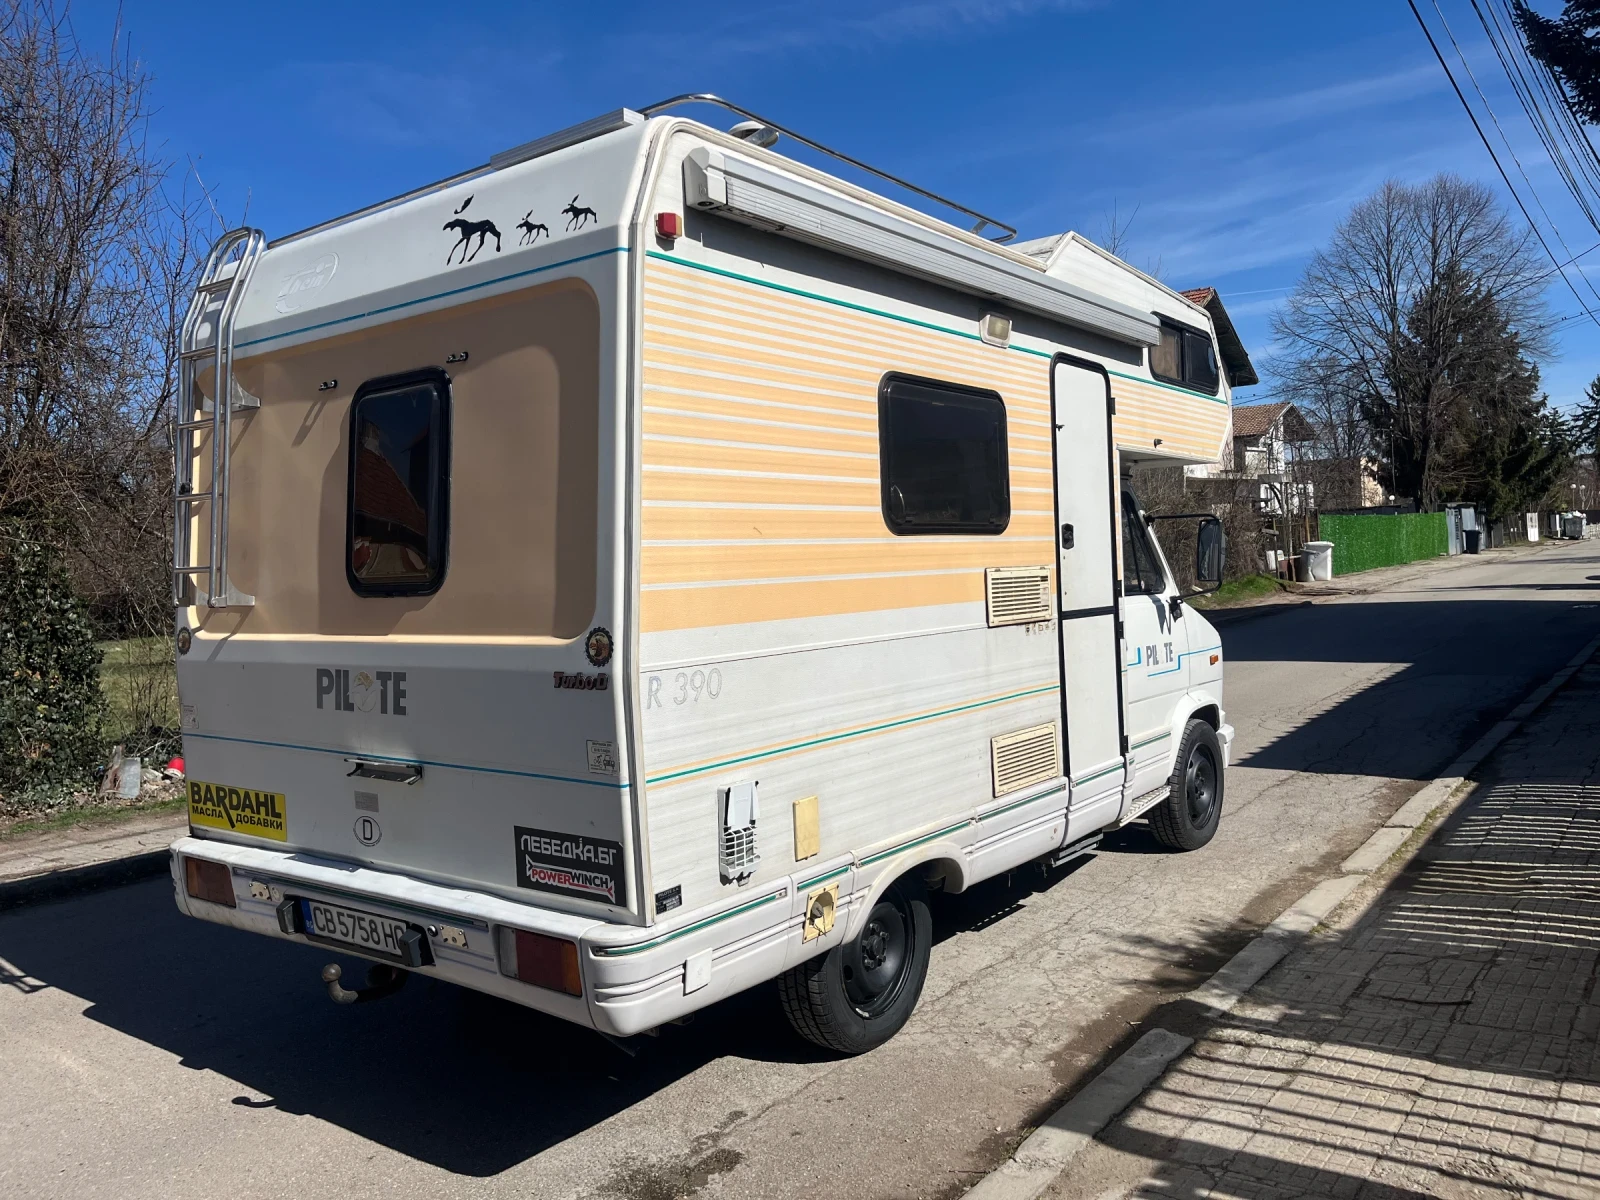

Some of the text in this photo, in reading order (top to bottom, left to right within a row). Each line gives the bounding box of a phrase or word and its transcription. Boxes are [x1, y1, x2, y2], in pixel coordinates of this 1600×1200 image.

[1146, 642, 1173, 666] PILTE
[553, 671, 594, 690] Turbo
[646, 668, 722, 709] R 390
[190, 781, 282, 828] BARDAHL
[192, 805, 283, 831] МАСЛА ДОБАВКИ
[362, 819, 373, 841] D
[531, 868, 610, 889] POWERWINCH
